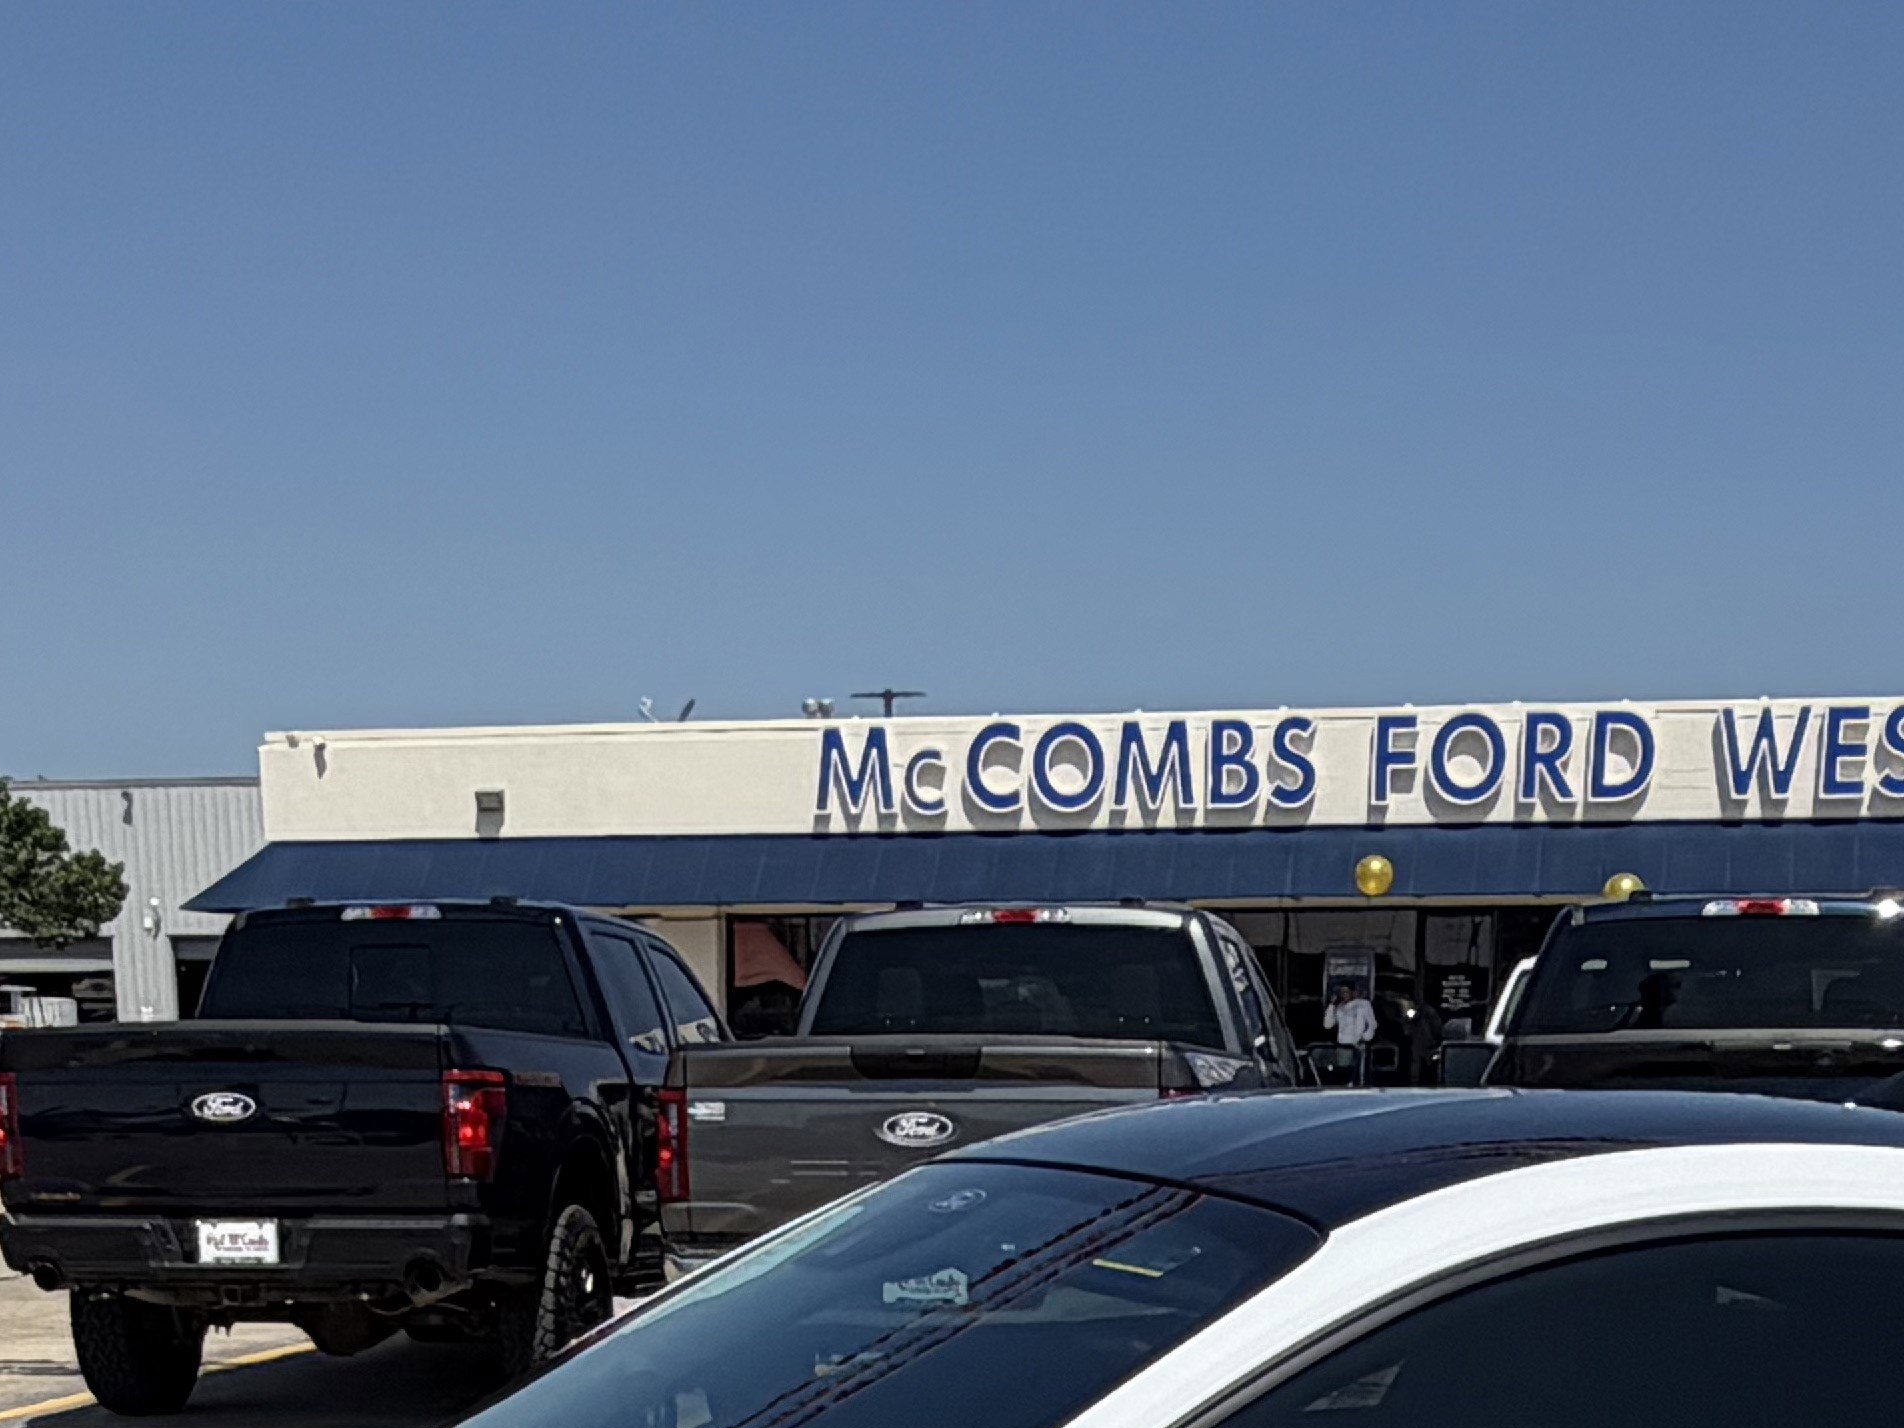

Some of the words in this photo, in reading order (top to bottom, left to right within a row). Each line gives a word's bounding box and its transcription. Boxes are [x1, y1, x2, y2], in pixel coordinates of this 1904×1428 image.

[816, 716, 1317, 813] McCOMBS
[1371, 709, 1657, 804] FORD
[199, 1095, 248, 1118] Ford
[891, 1115, 945, 1139] Ford
